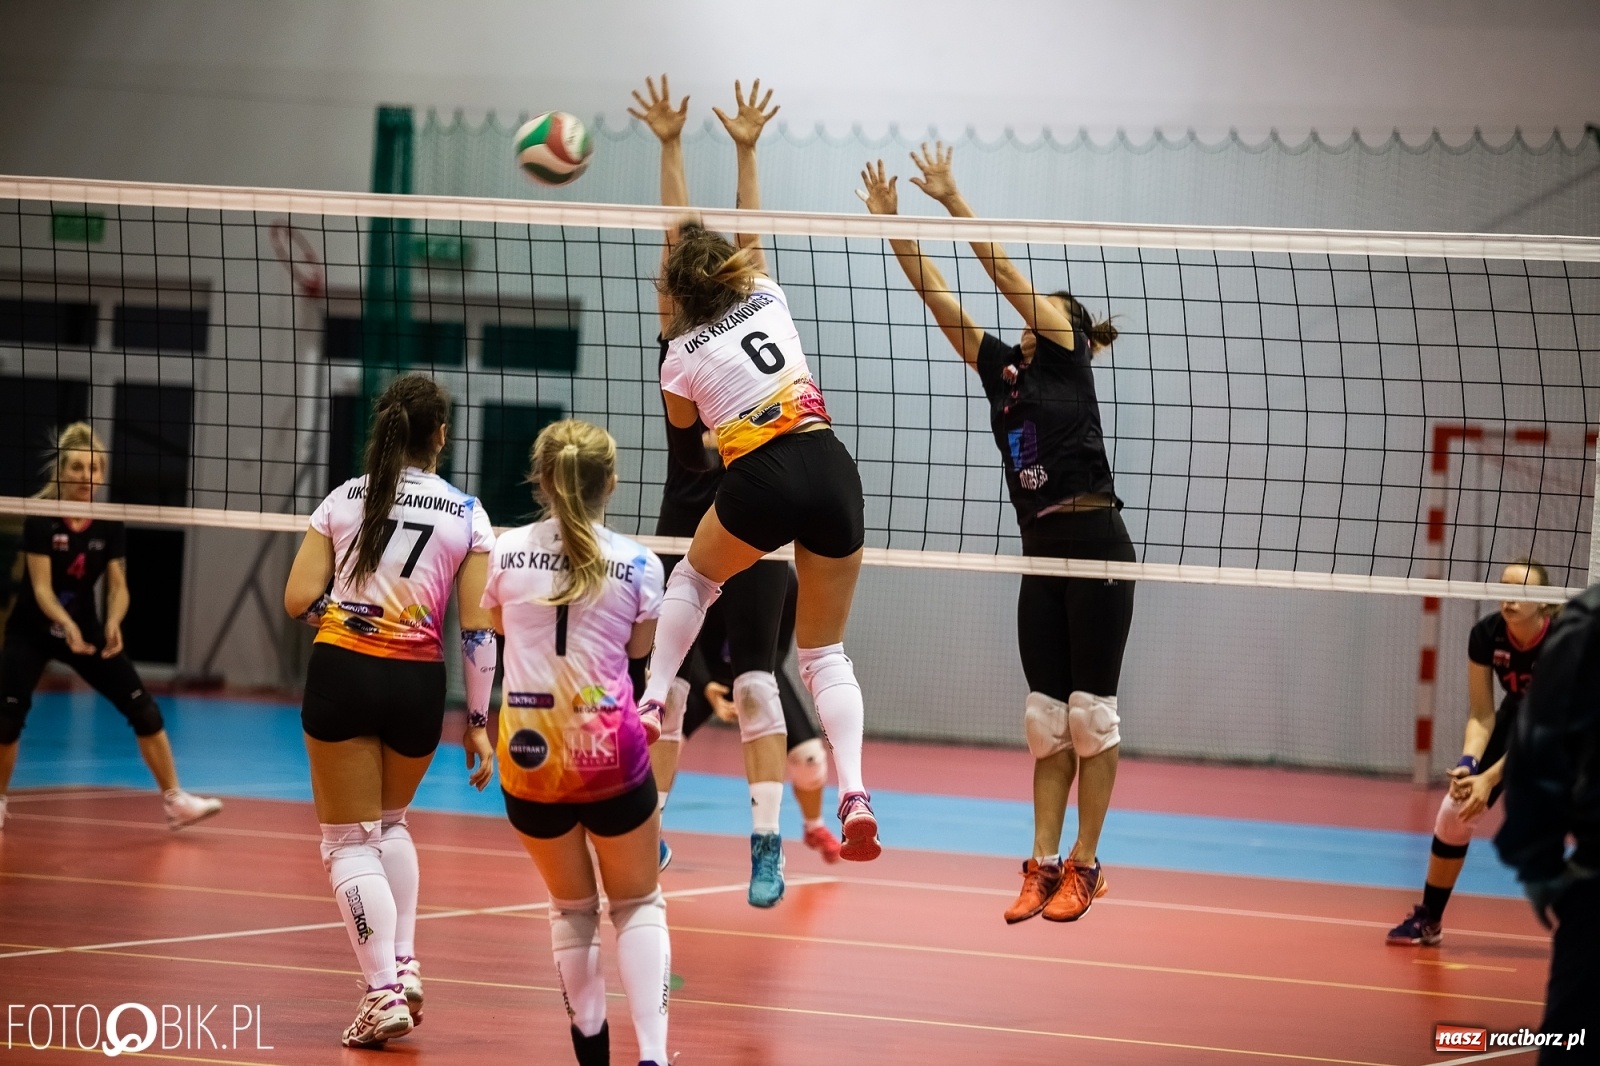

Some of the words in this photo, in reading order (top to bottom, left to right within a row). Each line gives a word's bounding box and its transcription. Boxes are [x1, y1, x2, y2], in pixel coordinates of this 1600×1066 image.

[684, 330, 711, 354] UKS
[709, 295, 774, 337] KRZANOWICE
[740, 331, 786, 375] 6
[394, 491, 467, 519] ZANOWICE
[501, 552, 526, 570] UKS
